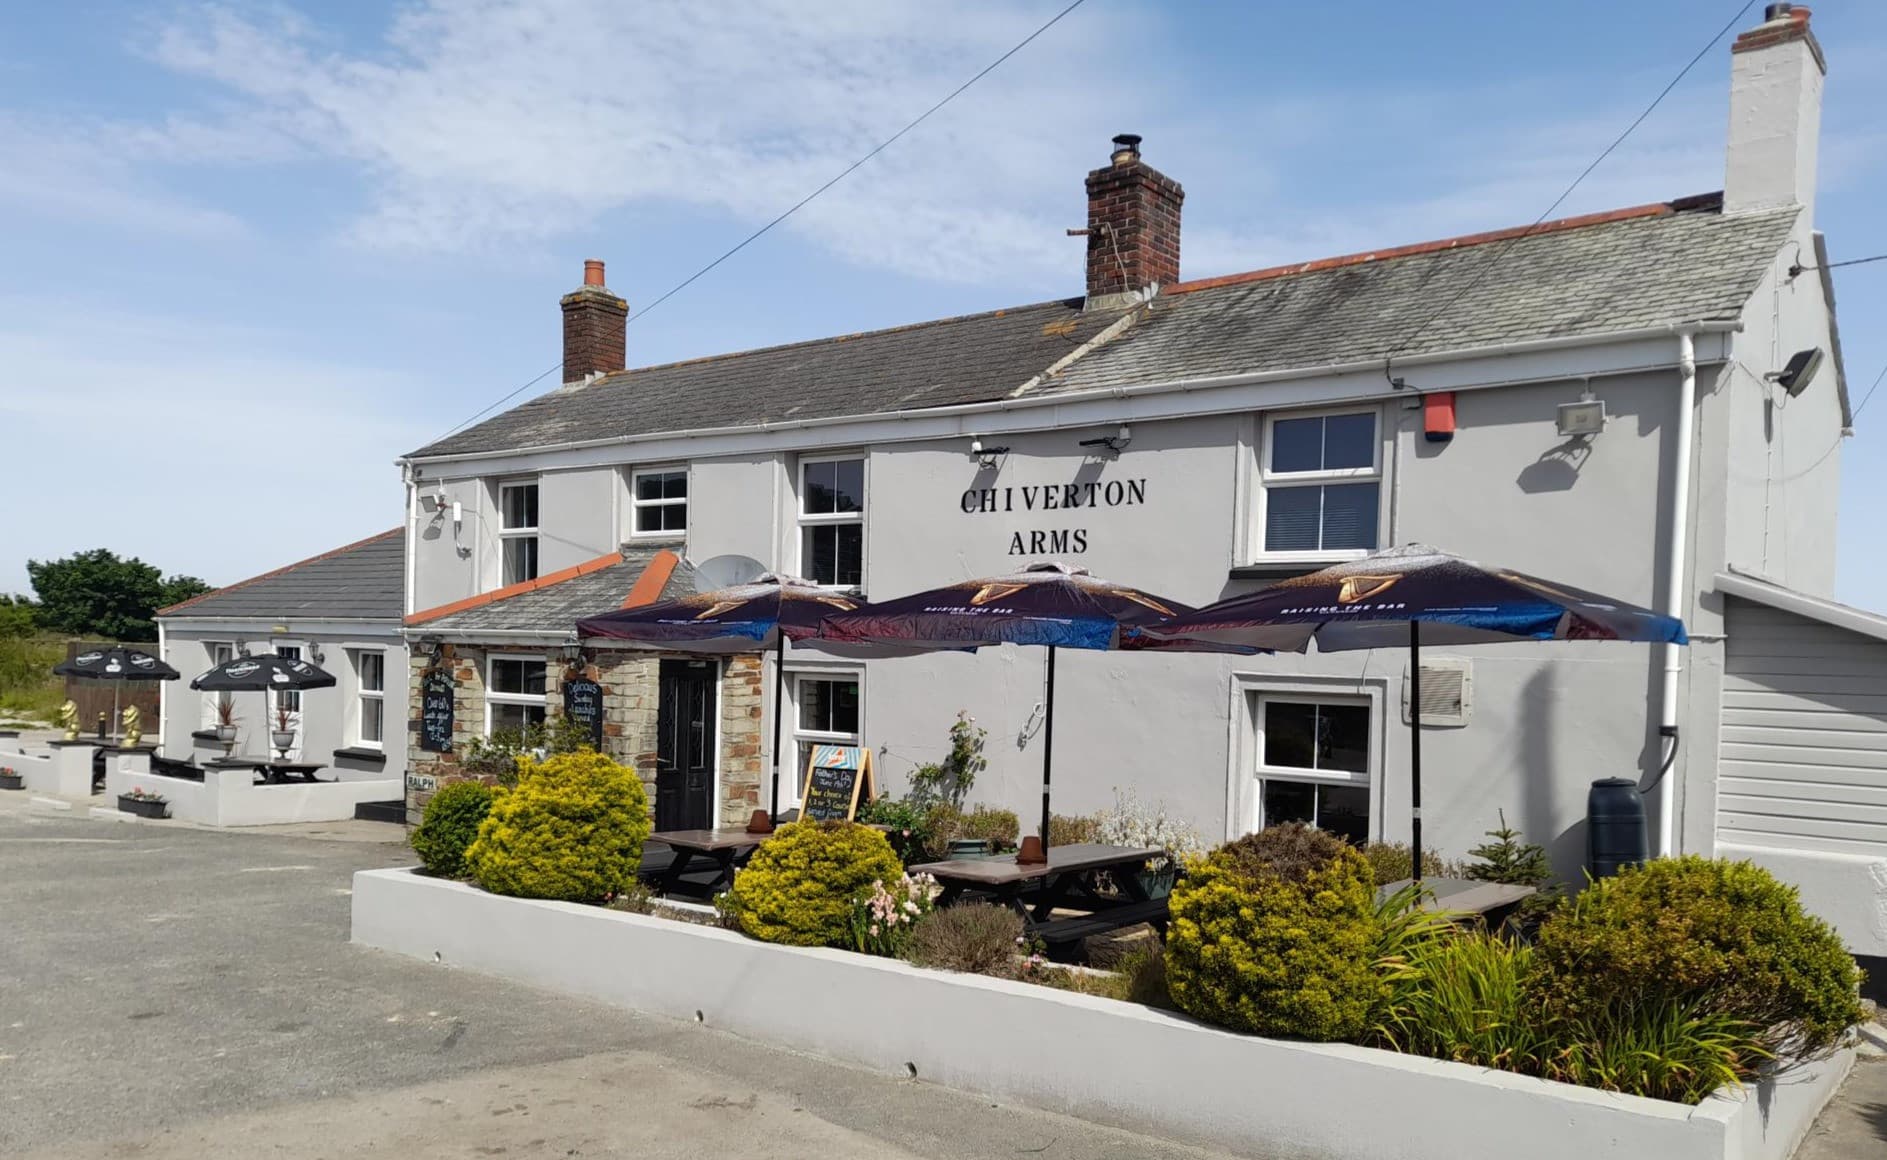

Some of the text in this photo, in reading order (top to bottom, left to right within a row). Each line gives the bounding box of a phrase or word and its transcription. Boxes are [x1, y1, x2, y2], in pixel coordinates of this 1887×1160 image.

[961, 479, 1146, 513] CHIVERTON
[1008, 529, 1088, 555] ARMS
[408, 775, 434, 788] RALPH
